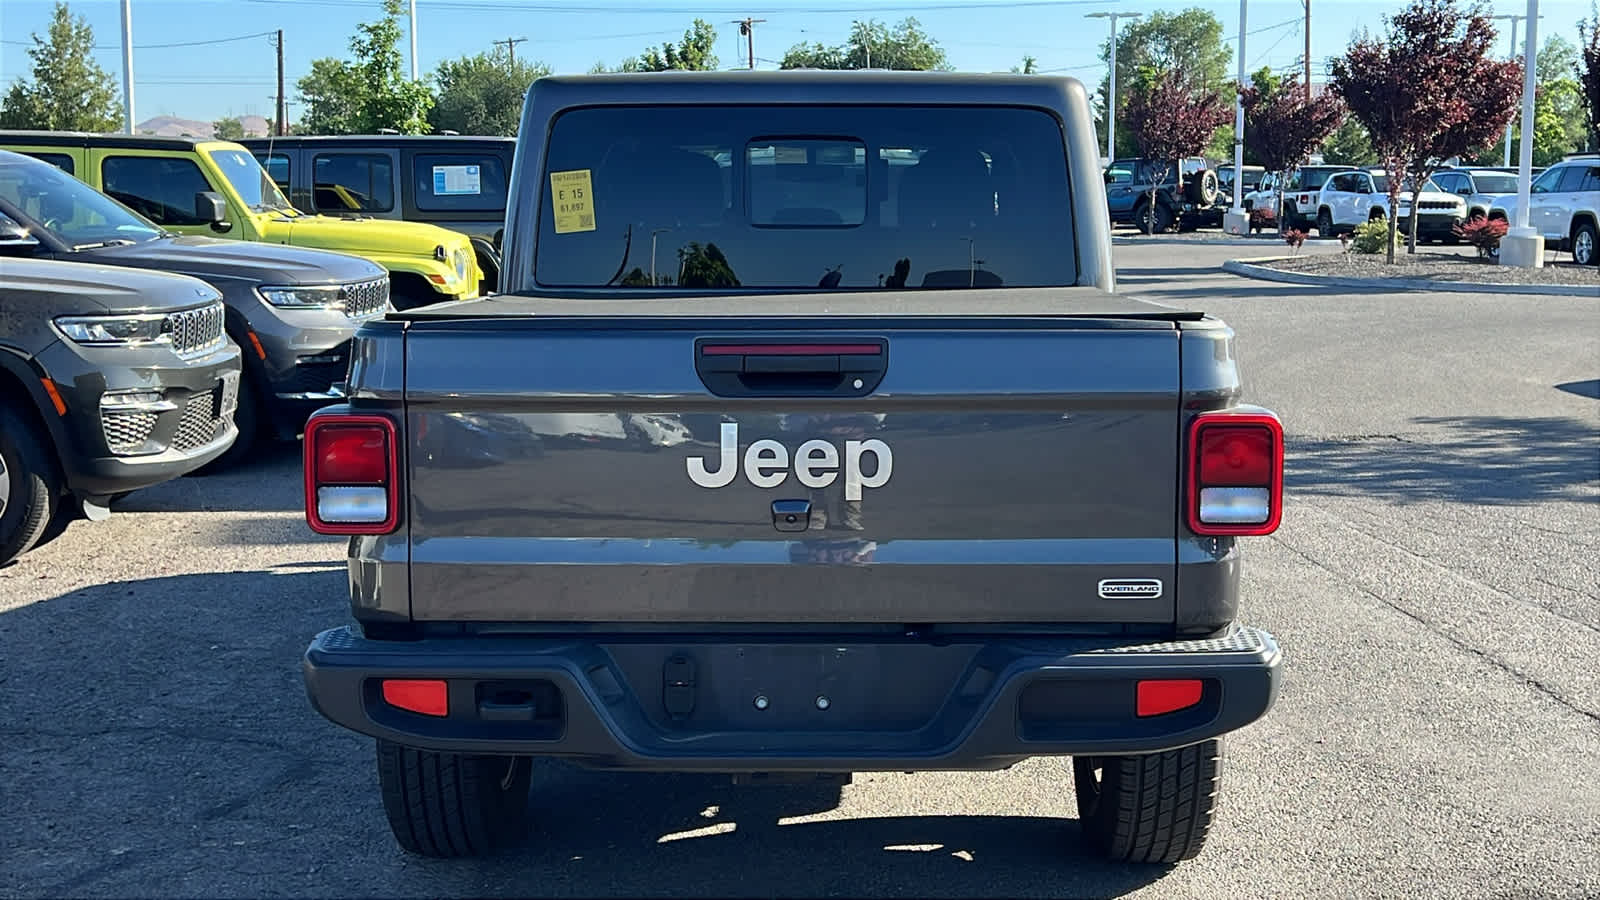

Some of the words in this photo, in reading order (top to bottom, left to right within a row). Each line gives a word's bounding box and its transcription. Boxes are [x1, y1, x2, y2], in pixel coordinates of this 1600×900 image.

[559, 190, 565, 200] E
[572, 189, 583, 199] 15
[686, 422, 893, 501] Jeep
